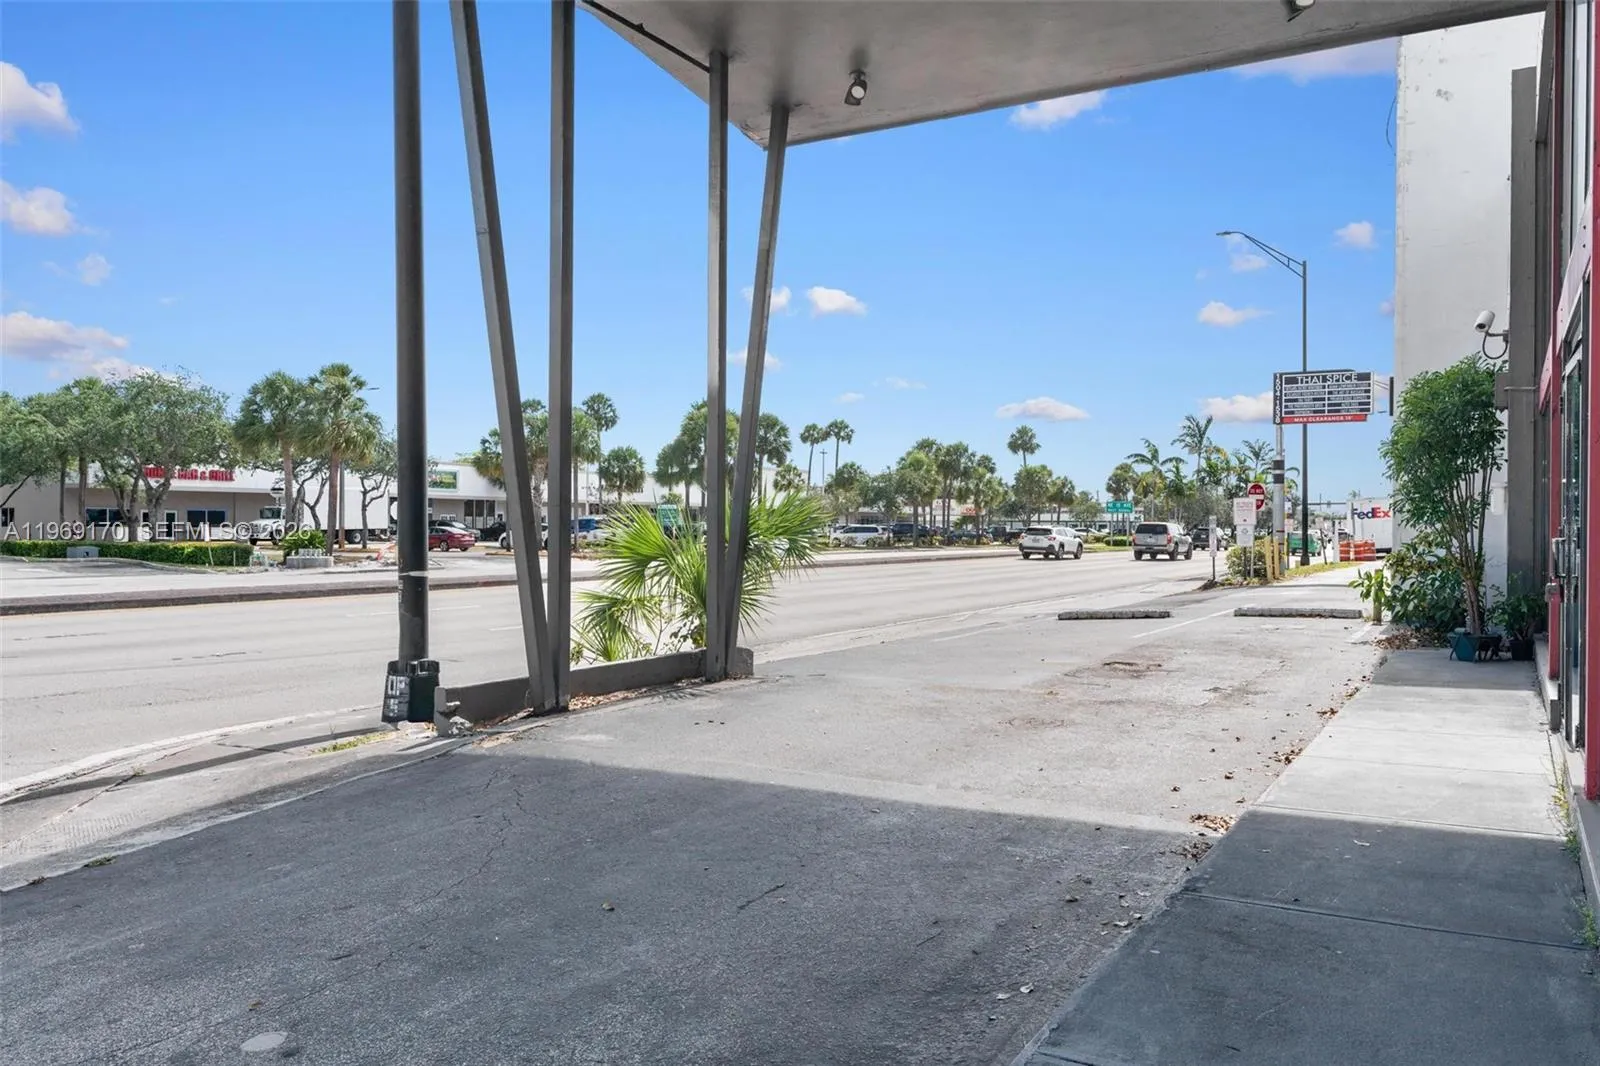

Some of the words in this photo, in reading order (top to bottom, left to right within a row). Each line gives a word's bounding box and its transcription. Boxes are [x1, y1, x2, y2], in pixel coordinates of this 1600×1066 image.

[1297, 375, 1323, 385] THAI
[1326, 373, 1358, 384] SPICE
[1351, 507, 1391, 520] FedEx
